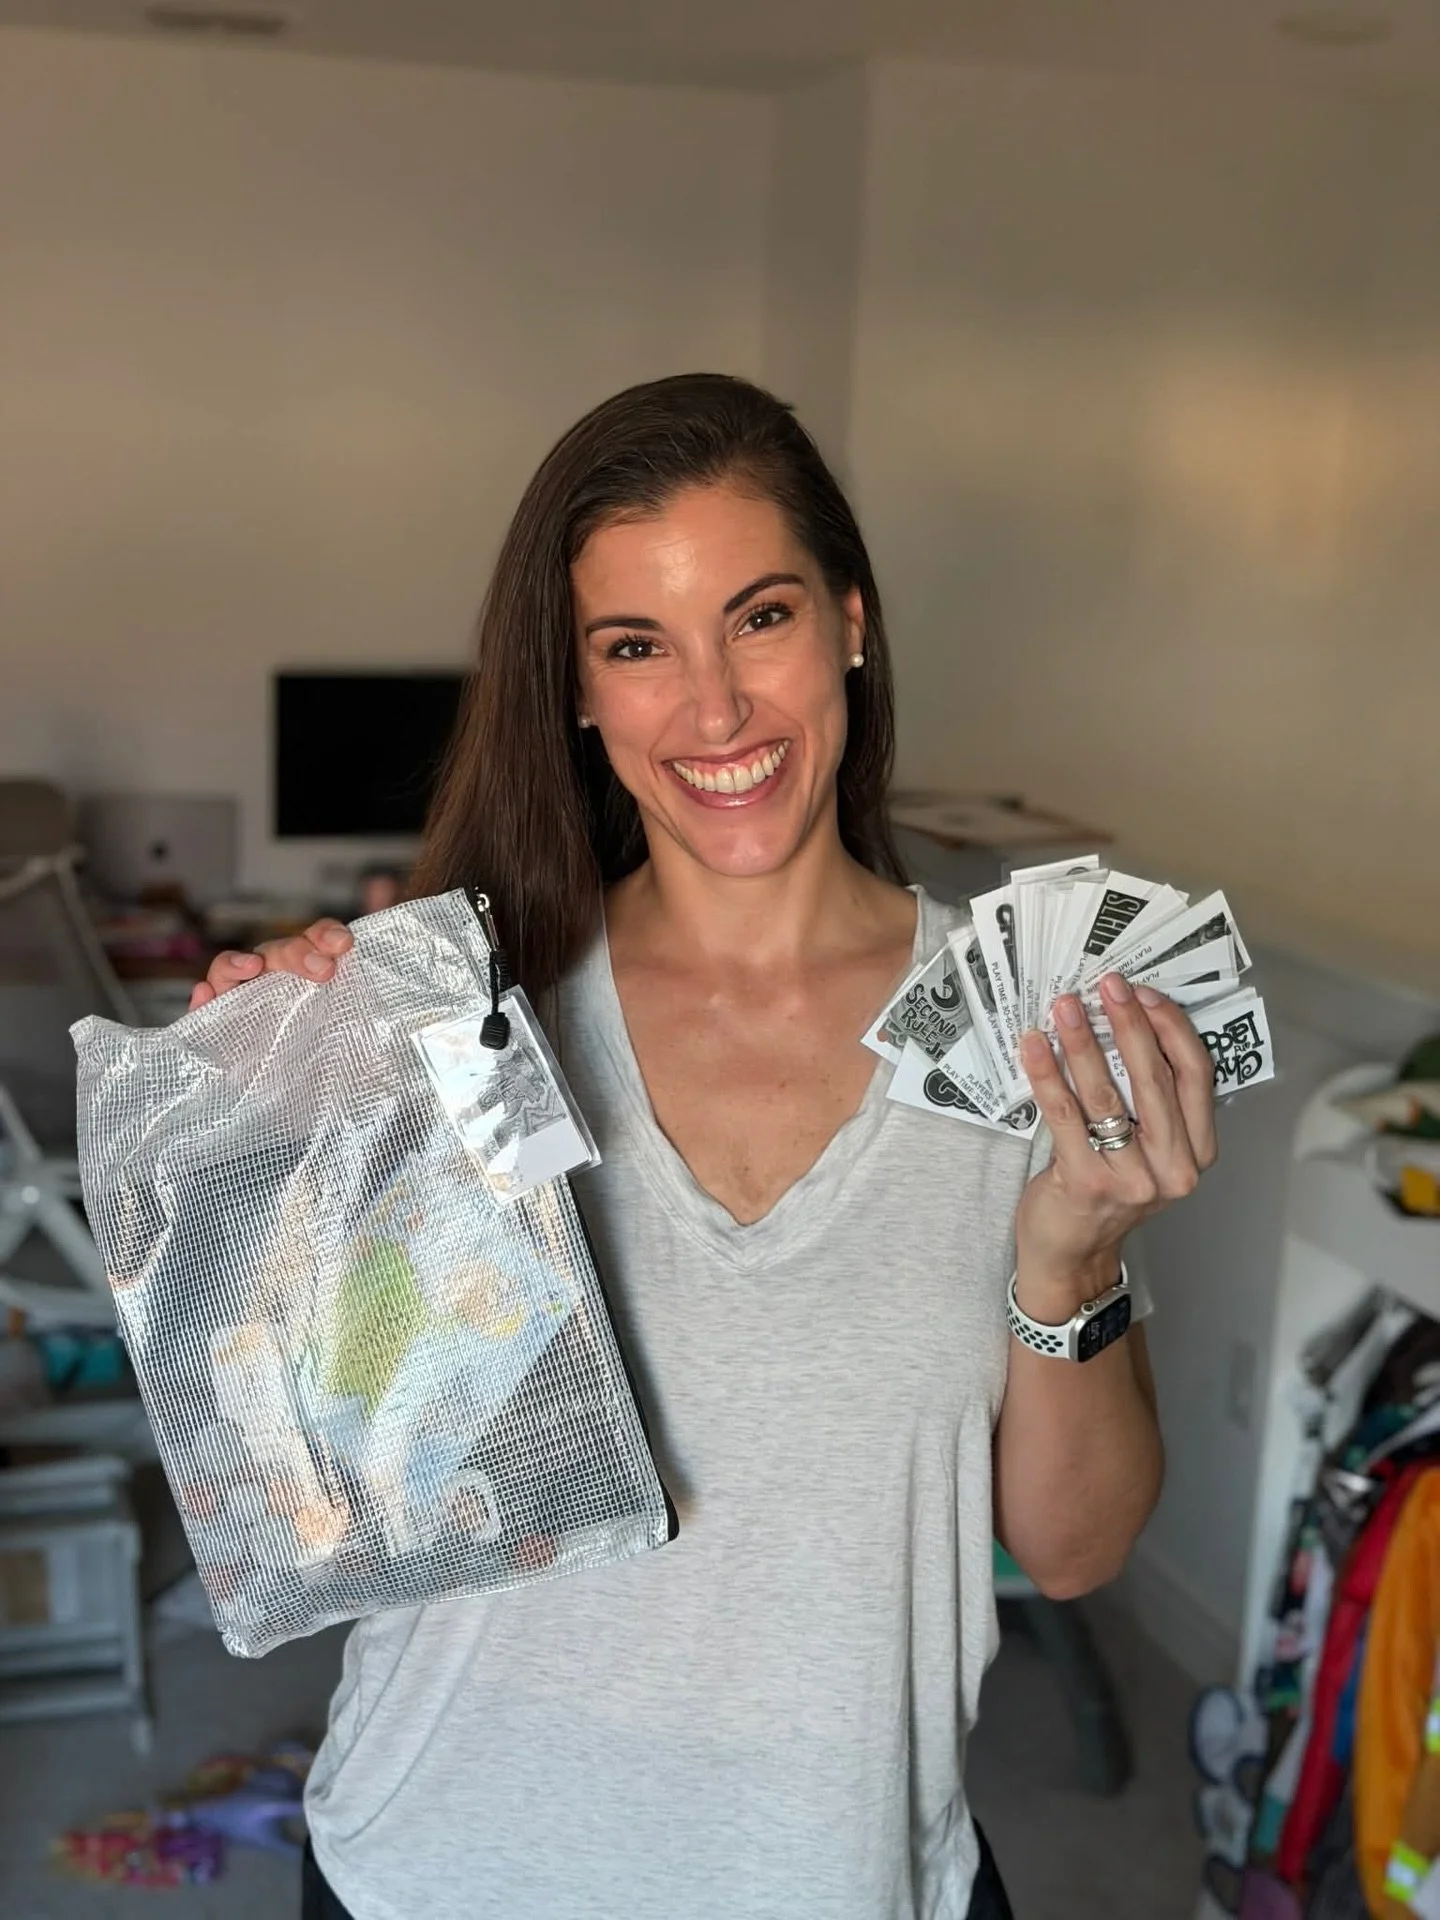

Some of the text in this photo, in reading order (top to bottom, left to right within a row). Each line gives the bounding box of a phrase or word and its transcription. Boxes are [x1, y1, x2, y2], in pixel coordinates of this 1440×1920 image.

[1134, 945, 1153, 961] PLAY
[992, 962, 1002, 982] PLAY
[996, 982, 1008, 1003] TIME:
[905, 983, 957, 1037] SECOND
[901, 1006, 938, 1042] RULE
[986, 1009, 998, 1030] PLAY
[994, 1029, 1007, 1048] TIME:
[1008, 1064, 1018, 1080] MIN
[1009, 1033, 1019, 1049] MIN
[943, 1063, 959, 1079] PLAY
[959, 1078, 976, 1095] TIME:
[973, 1093, 984, 1104] 30
[981, 1101, 996, 1115] MIN
[967, 1073, 993, 1100] PLAYERS:
